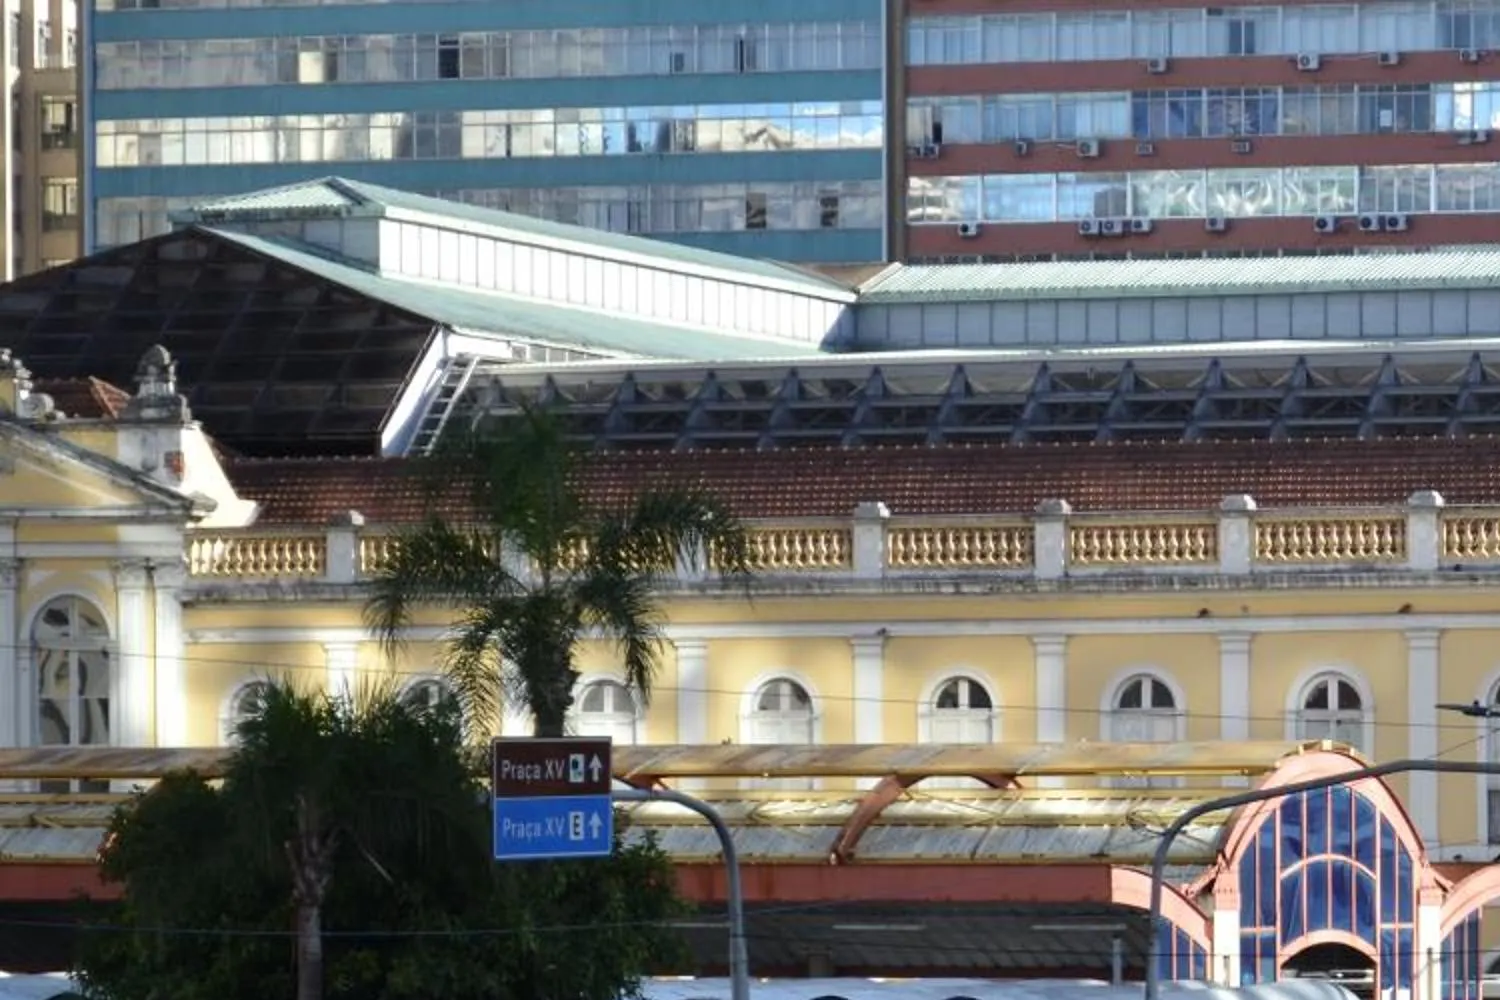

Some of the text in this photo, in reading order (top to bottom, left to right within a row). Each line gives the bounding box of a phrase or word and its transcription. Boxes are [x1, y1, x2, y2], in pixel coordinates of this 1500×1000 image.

[501, 759, 565, 784] Praça XV
[501, 815, 581, 843] Praça XV E
